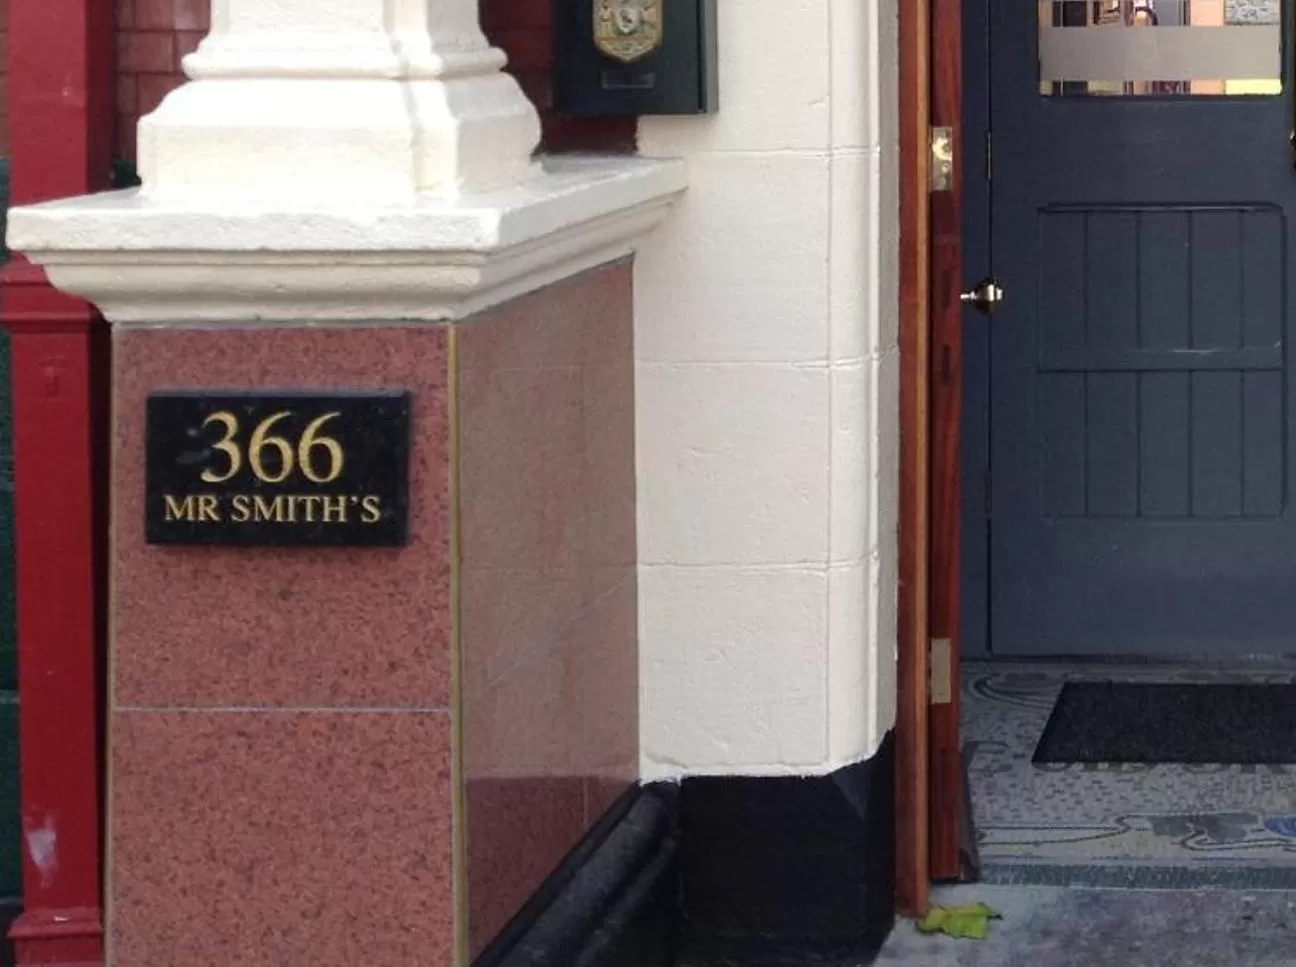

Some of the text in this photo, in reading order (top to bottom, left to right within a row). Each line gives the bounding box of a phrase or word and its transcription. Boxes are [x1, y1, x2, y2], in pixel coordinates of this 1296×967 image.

[200, 410, 344, 483] 366
[163, 493, 382, 524] MR SMITH'S
